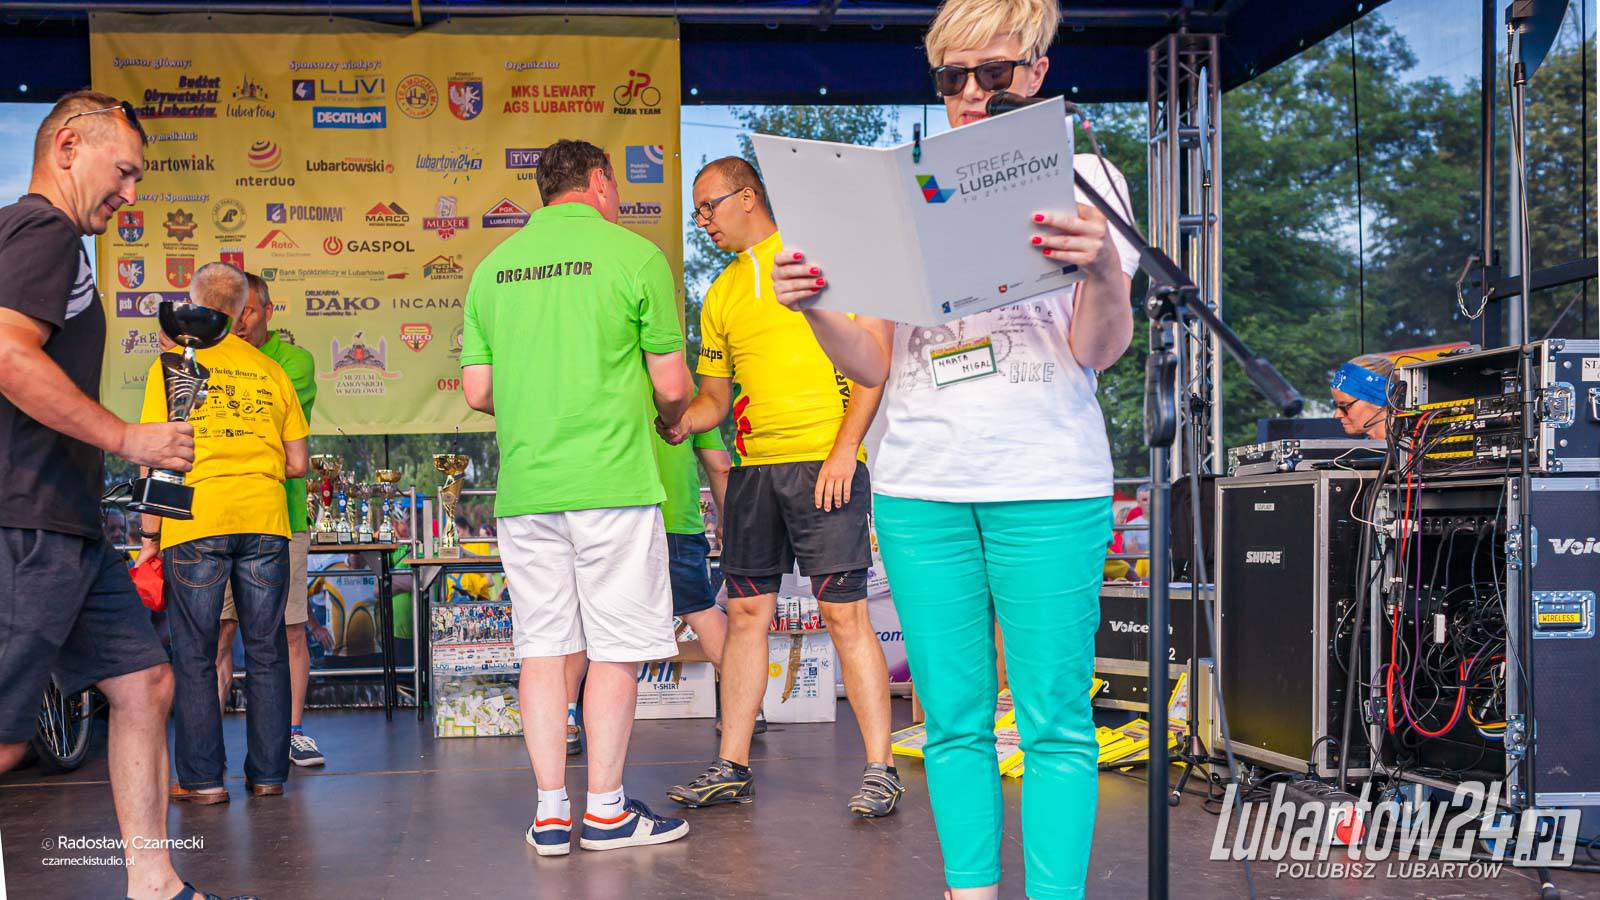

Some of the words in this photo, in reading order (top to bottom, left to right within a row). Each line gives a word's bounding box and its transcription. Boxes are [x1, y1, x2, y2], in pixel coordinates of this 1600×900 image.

[503, 60, 560, 70] Organizator
[178, 75, 221, 88] Budżet
[320, 78, 385, 94] LUVI
[511, 85, 538, 98] MKS
[543, 85, 596, 98] LEWART
[503, 101, 529, 113] AGS
[533, 98, 605, 113] LUBARTÓW
[639, 107, 661, 115] TEAM
[317, 111, 382, 124] DECATHLON
[143, 155, 215, 172] bartowiak
[511, 152, 541, 164] TVP
[306, 160, 385, 173] Lubartowski
[956, 149, 1025, 182] STREFA
[959, 153, 1058, 195] LUBARTÓW
[235, 177, 296, 187] interduo
[366, 215, 409, 223] MARCO
[426, 219, 465, 228] MLEXER
[271, 241, 294, 249] Roto
[347, 240, 415, 253] GASPOL
[496, 261, 593, 284] ORGANIZATOR
[305, 296, 380, 311] DAKO
[392, 298, 463, 309] INCANA
[436, 378, 460, 391] OSP
[1246, 551, 1281, 564] SHURE
[1542, 614, 1575, 622] WIRELESS
